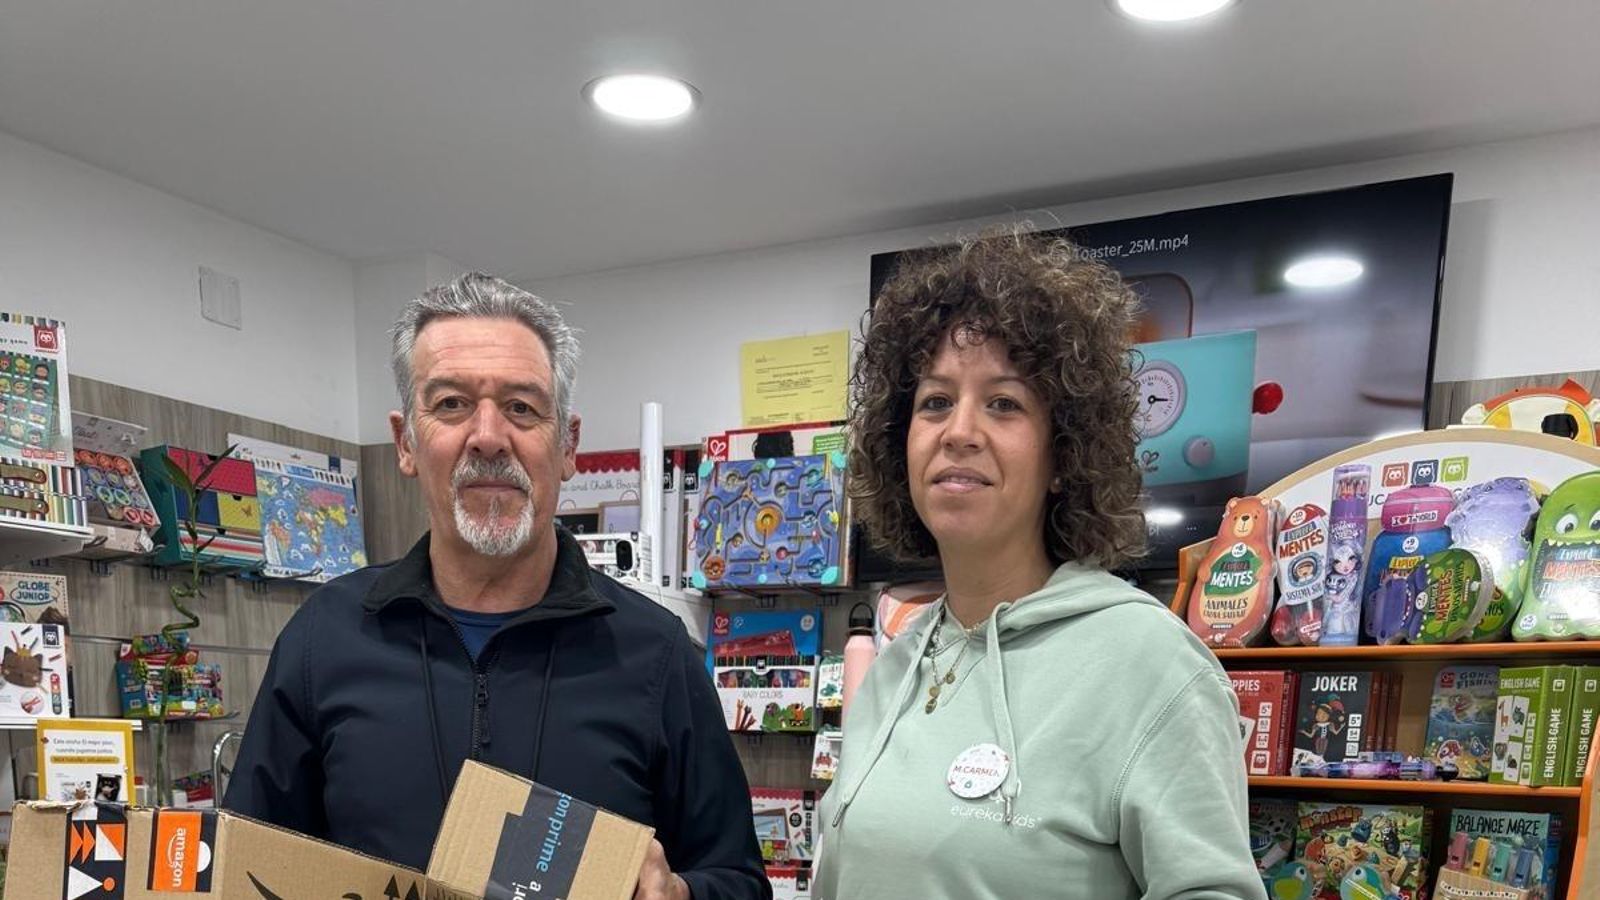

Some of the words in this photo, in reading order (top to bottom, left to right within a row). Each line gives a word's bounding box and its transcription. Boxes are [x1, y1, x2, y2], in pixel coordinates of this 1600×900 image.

[1280, 529, 1325, 559] MENTES
[18, 580, 51, 592] GLOBE
[1210, 570, 1254, 588] MENTES
[17, 591, 50, 601] JUNIOR
[1312, 676, 1359, 692] JOKER
[1548, 708, 1562, 735] GAME
[1581, 708, 1593, 735] GAME
[1544, 736, 1558, 778] ENGLISH
[1456, 814, 1506, 834] BALANCE
[1506, 817, 1540, 837] MAZE
[172, 827, 188, 888] amazon
[536, 816, 564, 873] prime
